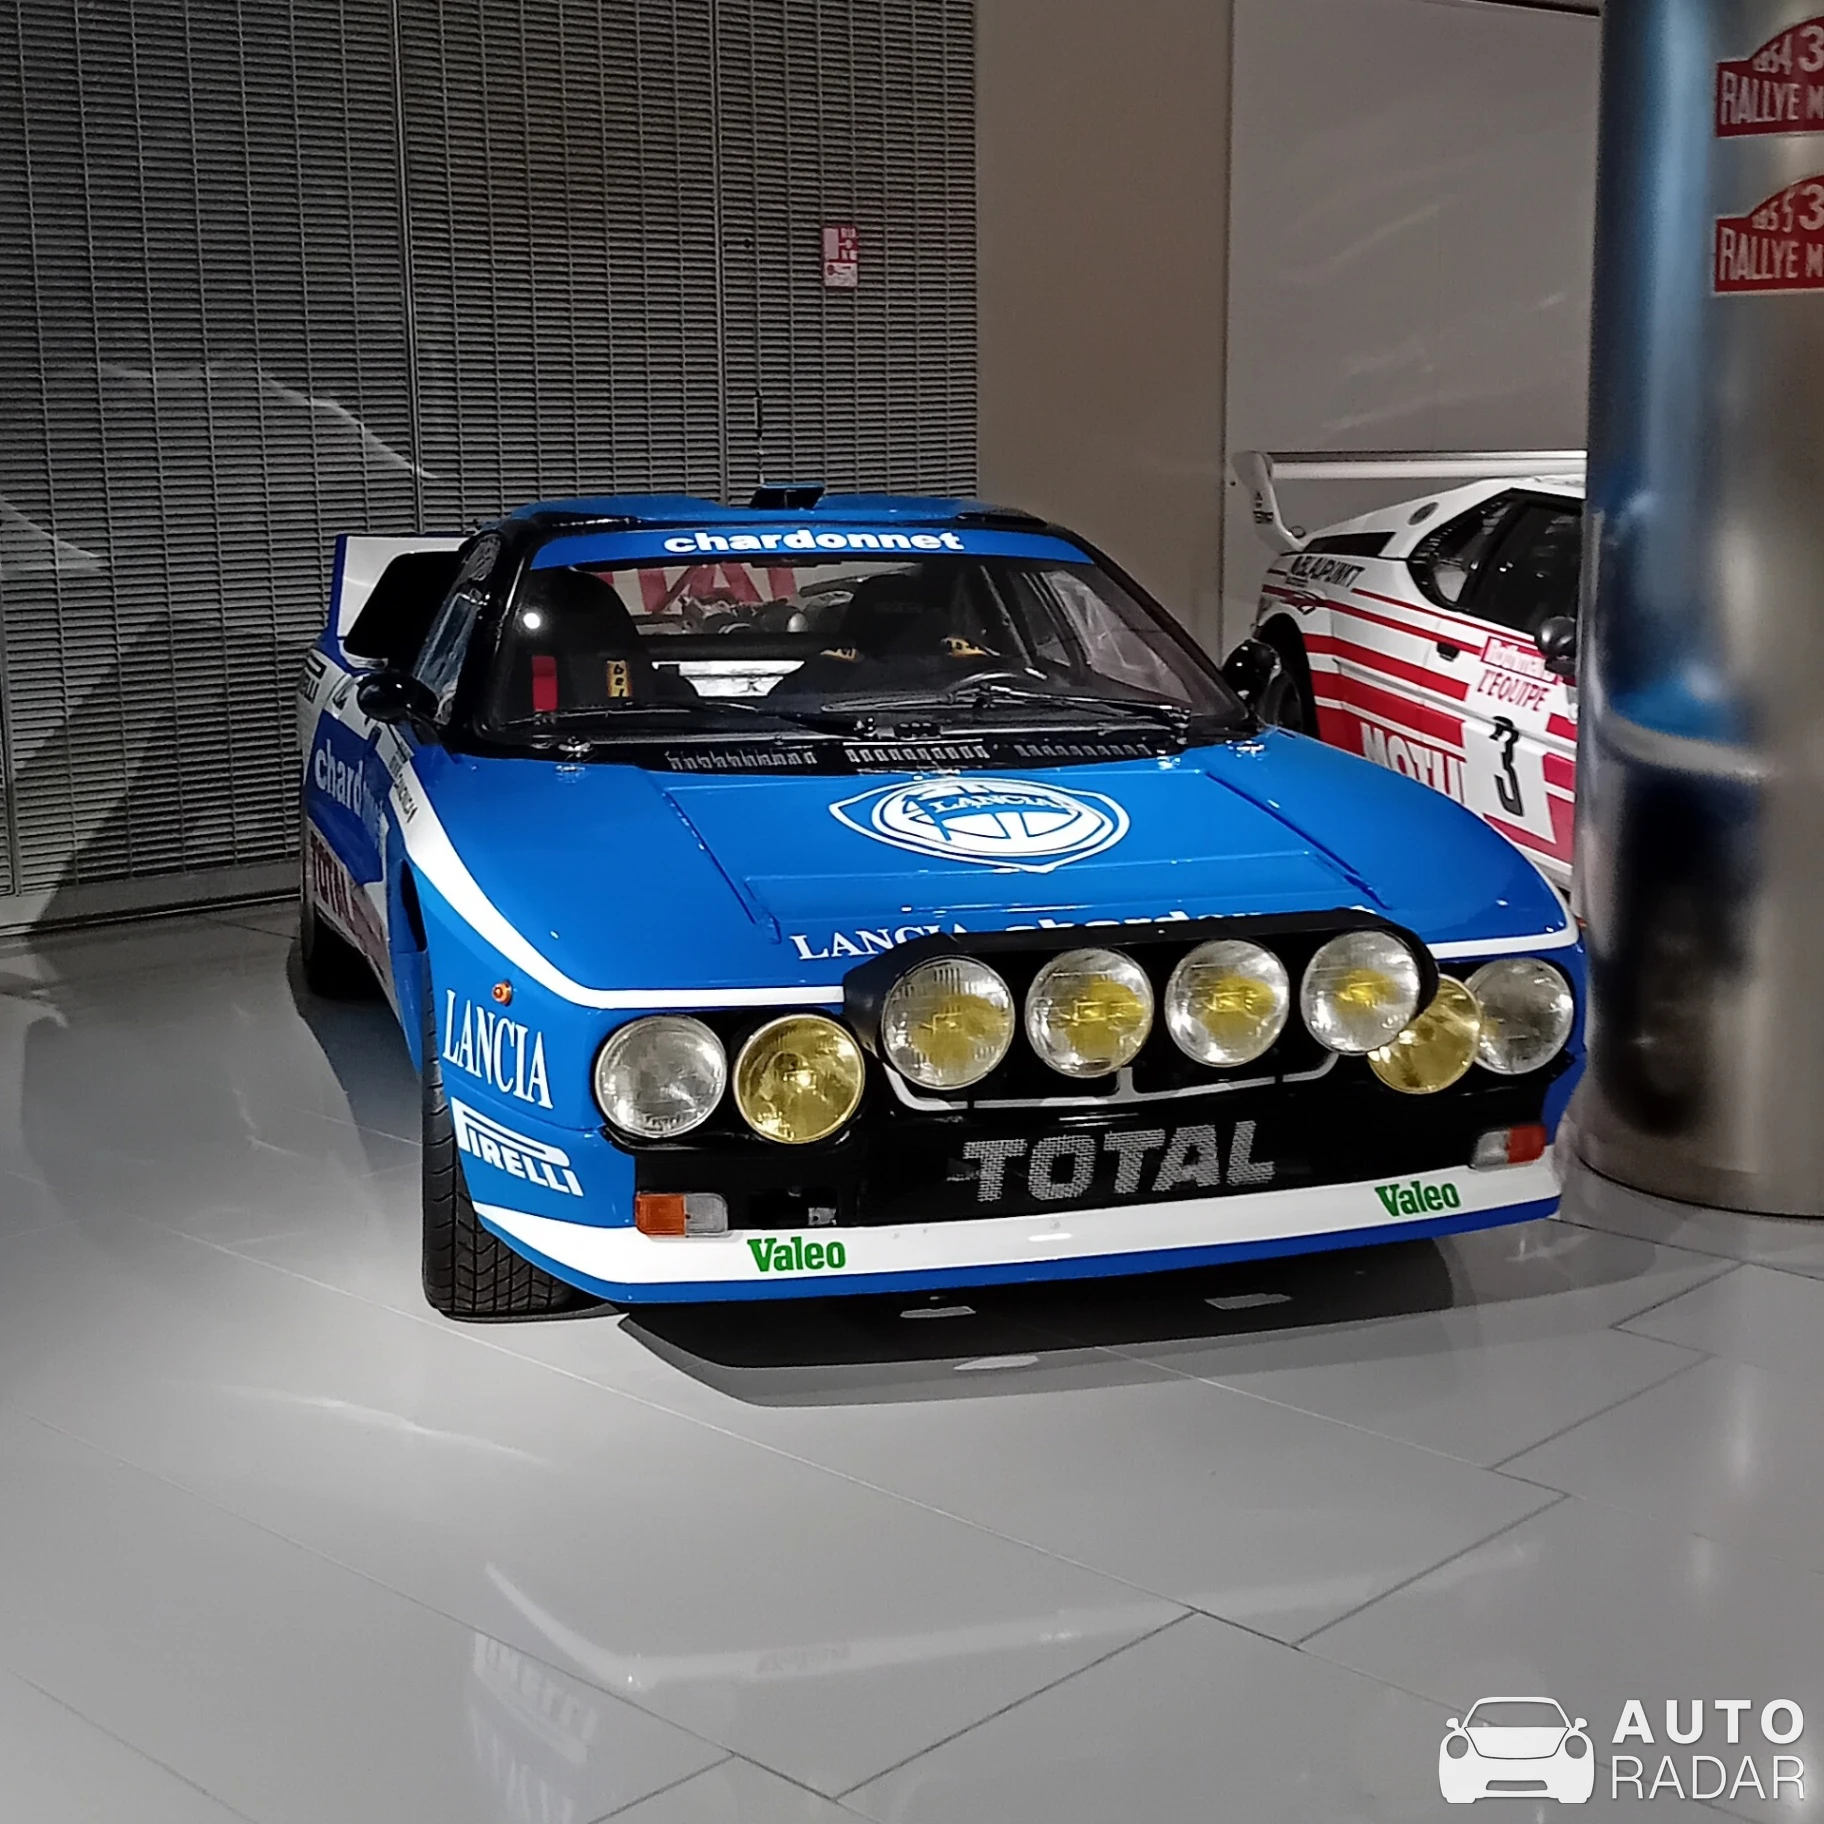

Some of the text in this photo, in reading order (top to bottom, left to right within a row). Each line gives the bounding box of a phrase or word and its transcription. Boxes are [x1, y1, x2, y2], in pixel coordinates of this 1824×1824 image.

[1720, 71, 1800, 125] RALLYE
[1719, 226, 1800, 280] RALLYE
[663, 529, 966, 553] chardonnet
[1360, 721, 1465, 806] MOTU
[1489, 715, 1525, 818] 3
[928, 794, 1070, 814] LANCIA
[788, 922, 968, 960] LANC
[442, 989, 554, 1110] LANCIA
[450, 1096, 585, 1198] PIRELLI
[962, 1120, 1276, 1203] TOTAL
[1374, 1180, 1461, 1218] Valeo
[746, 1236, 846, 1273] Valeo
